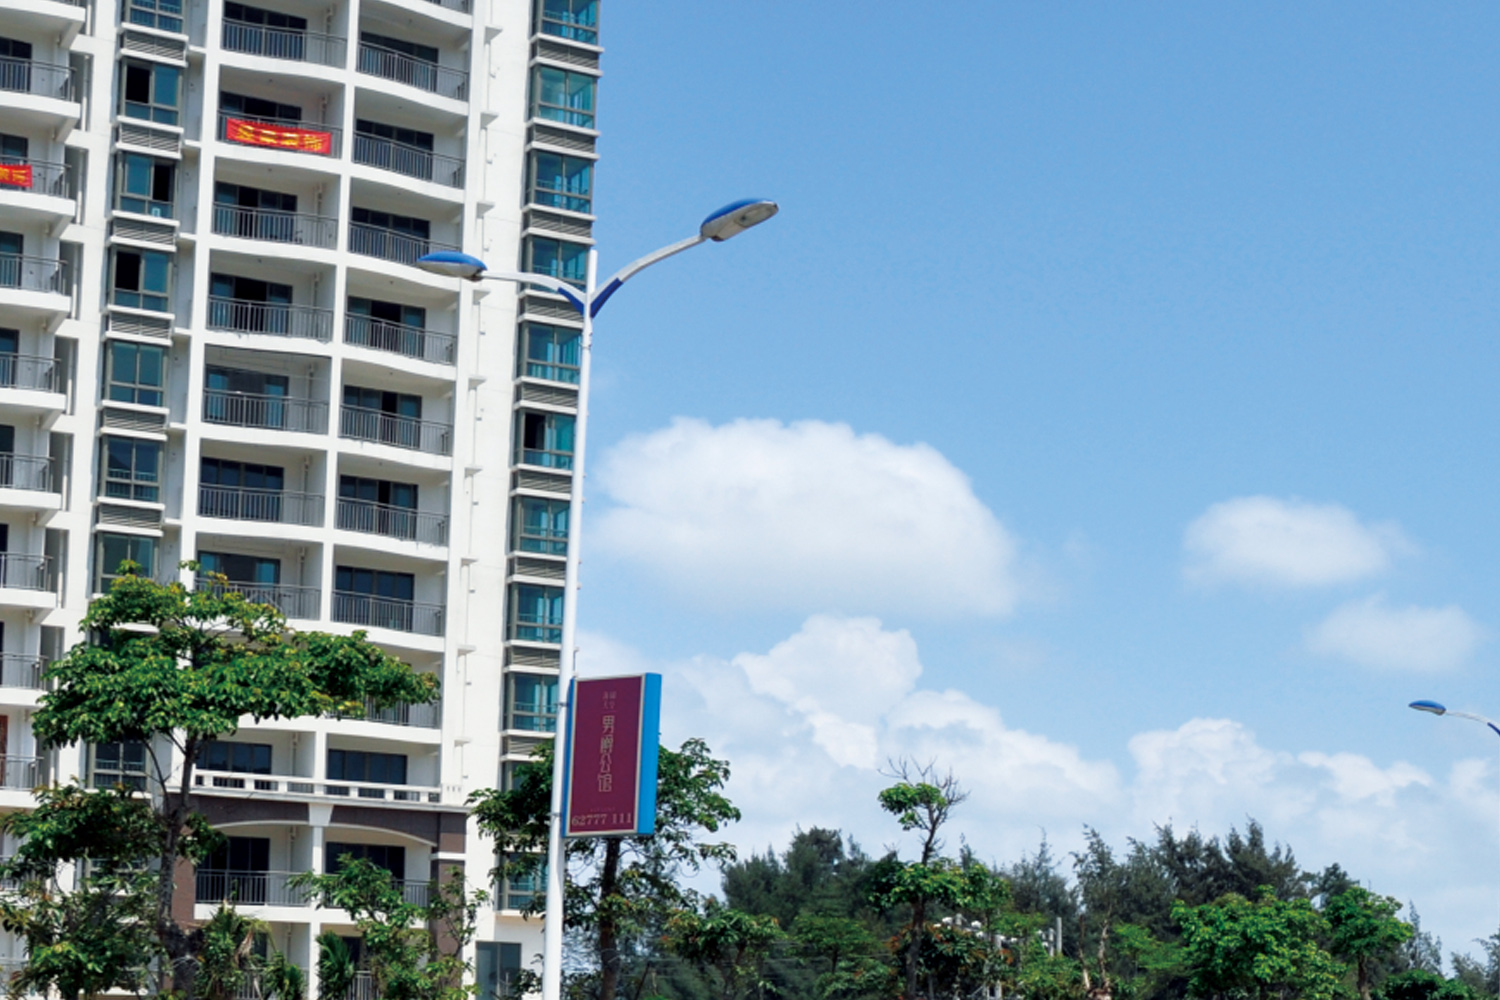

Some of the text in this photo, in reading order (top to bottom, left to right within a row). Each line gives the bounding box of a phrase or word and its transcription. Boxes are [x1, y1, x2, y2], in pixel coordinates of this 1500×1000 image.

[598, 715, 615, 793] 男爵公馆
[572, 812, 632, 826] 62777 111
